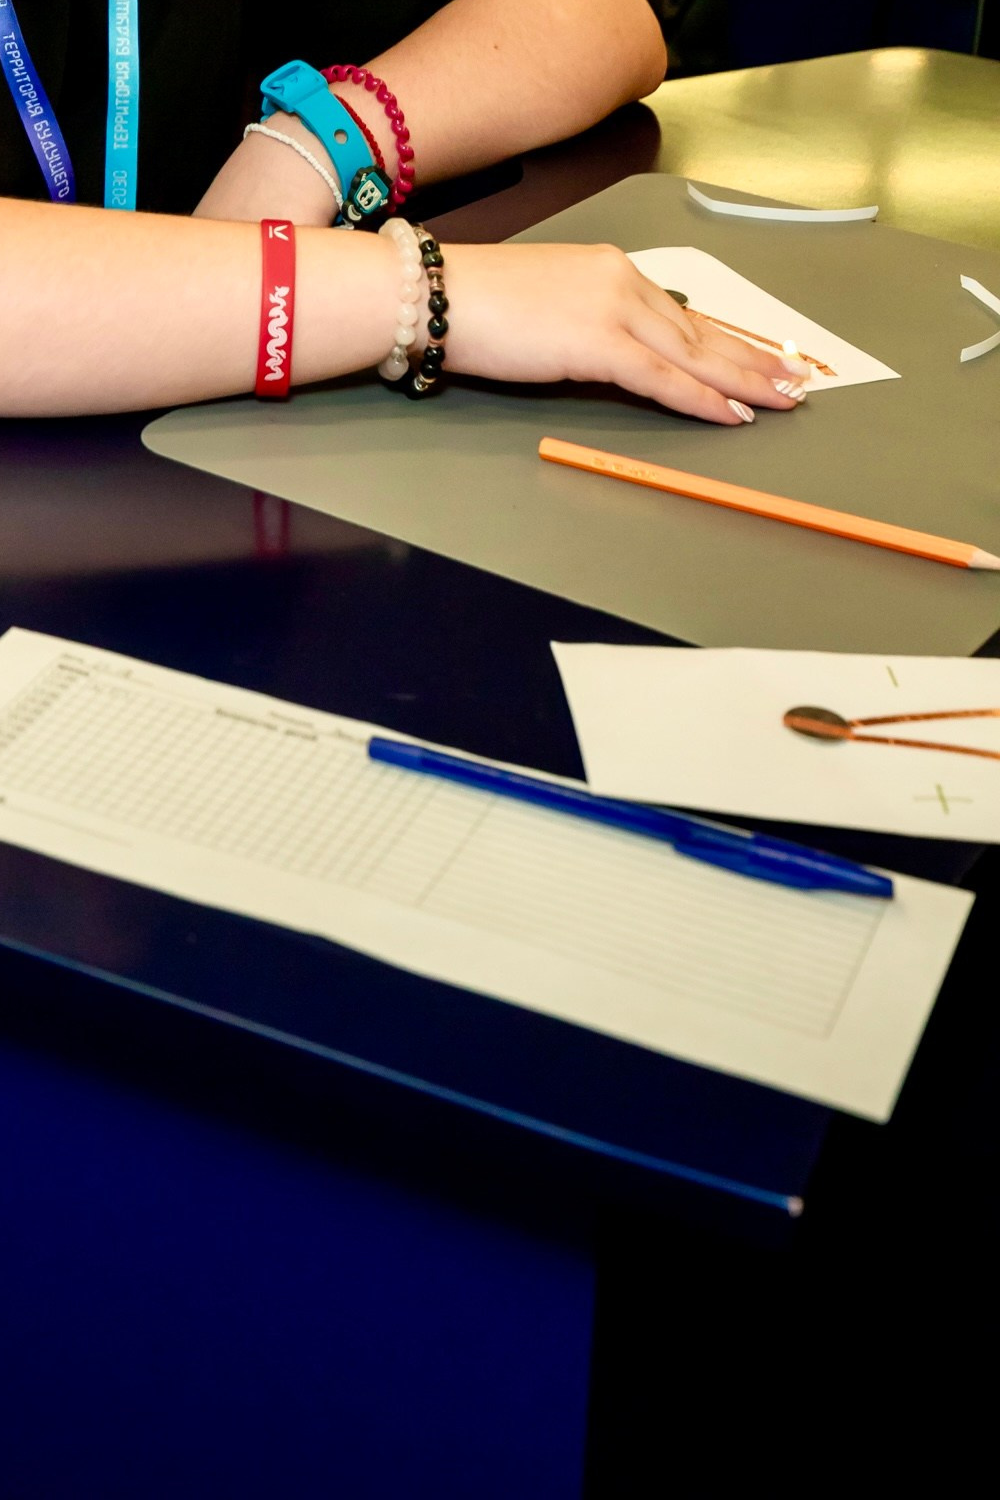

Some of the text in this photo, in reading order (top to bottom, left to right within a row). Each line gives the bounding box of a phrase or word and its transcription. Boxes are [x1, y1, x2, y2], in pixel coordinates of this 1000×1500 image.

[2, 31, 44, 118] ТЕРРИТОРИЯ
[33, 118, 71, 199] БУДУЩЕГО
[113, 62, 131, 150] ТЕРРИТОРИЯ
[112, 170, 127, 206] 2030
